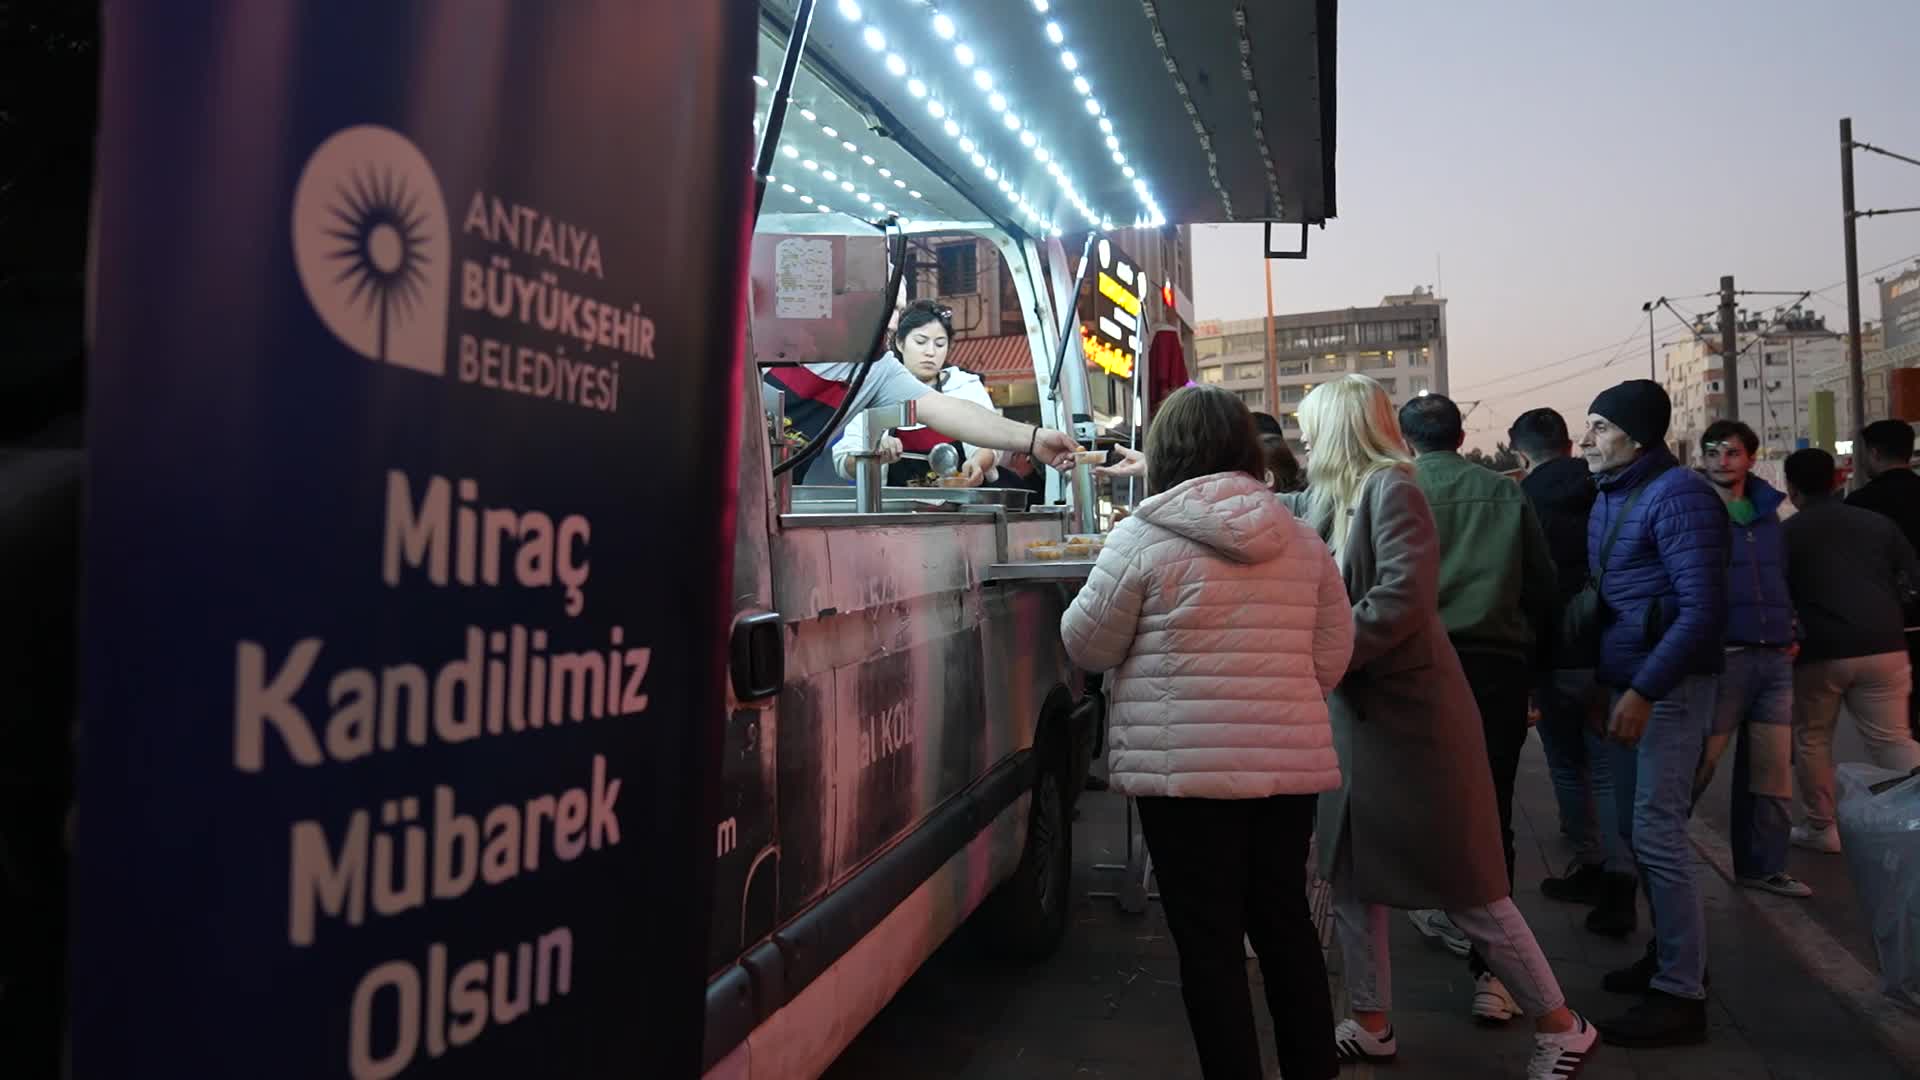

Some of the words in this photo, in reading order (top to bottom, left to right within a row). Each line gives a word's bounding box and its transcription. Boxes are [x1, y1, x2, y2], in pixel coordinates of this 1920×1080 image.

[464, 191, 604, 278] ANTALYA
[458, 335, 619, 412] BELEDİYESİ
[461, 257, 656, 360] BÜYÜKŞEHİR
[382, 469, 591, 616] Miraç
[234, 625, 651, 772] Kandilimiz
[289, 755, 622, 946] Mübarek
[349, 927, 573, 1080] Olsun
